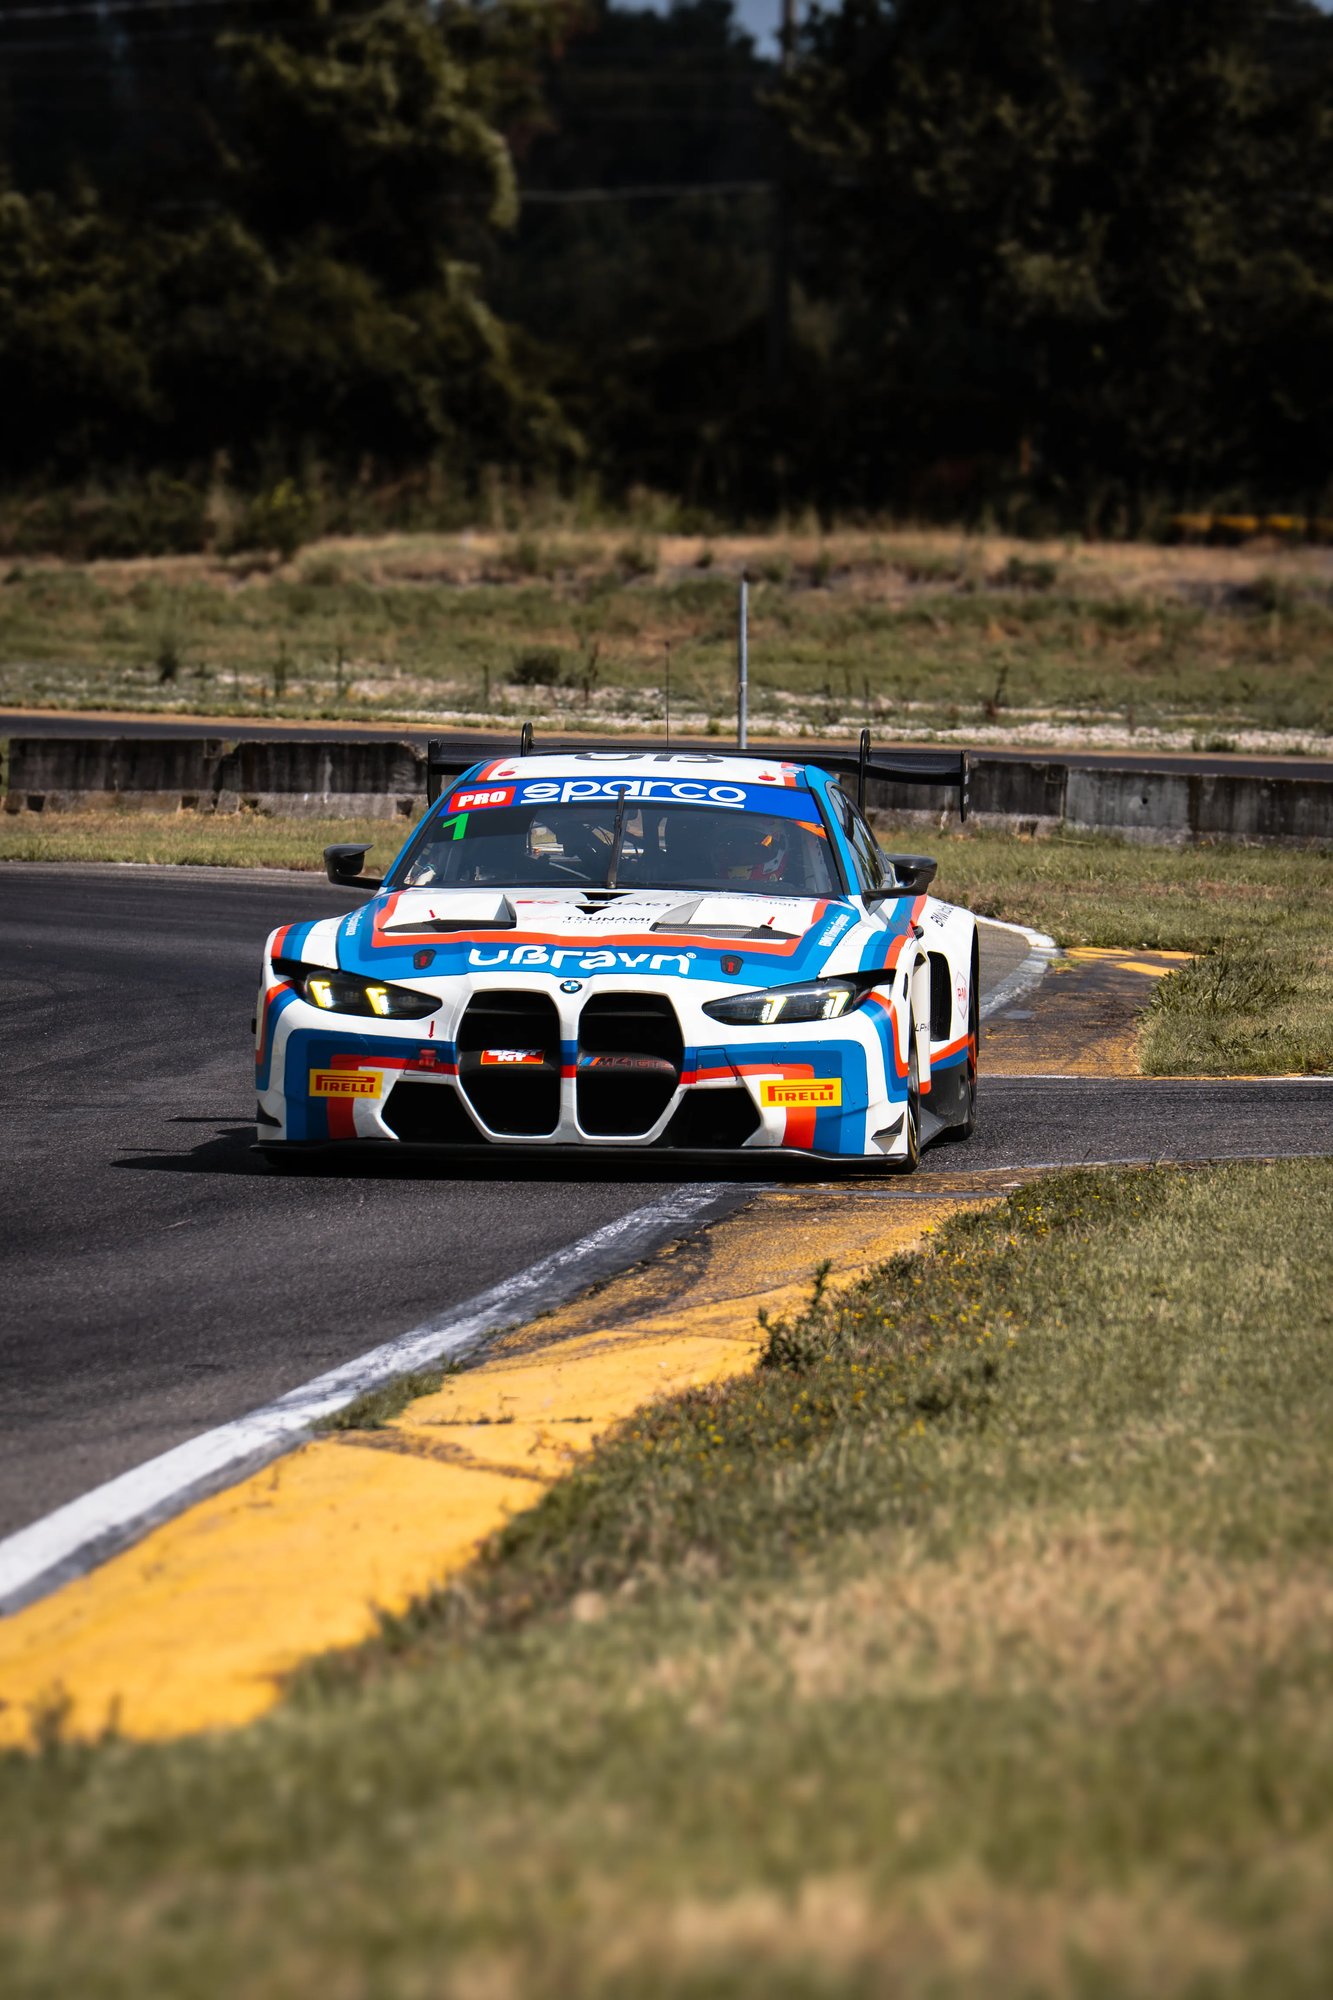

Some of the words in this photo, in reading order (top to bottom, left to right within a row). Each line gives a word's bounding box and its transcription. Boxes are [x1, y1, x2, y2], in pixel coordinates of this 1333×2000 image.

[457, 790, 508, 807] PRO
[522, 780, 747, 803] sparco
[442, 813, 470, 840] 1
[316, 1074, 376, 1093] PIRELLI
[767, 1084, 834, 1102] PIRELLI
